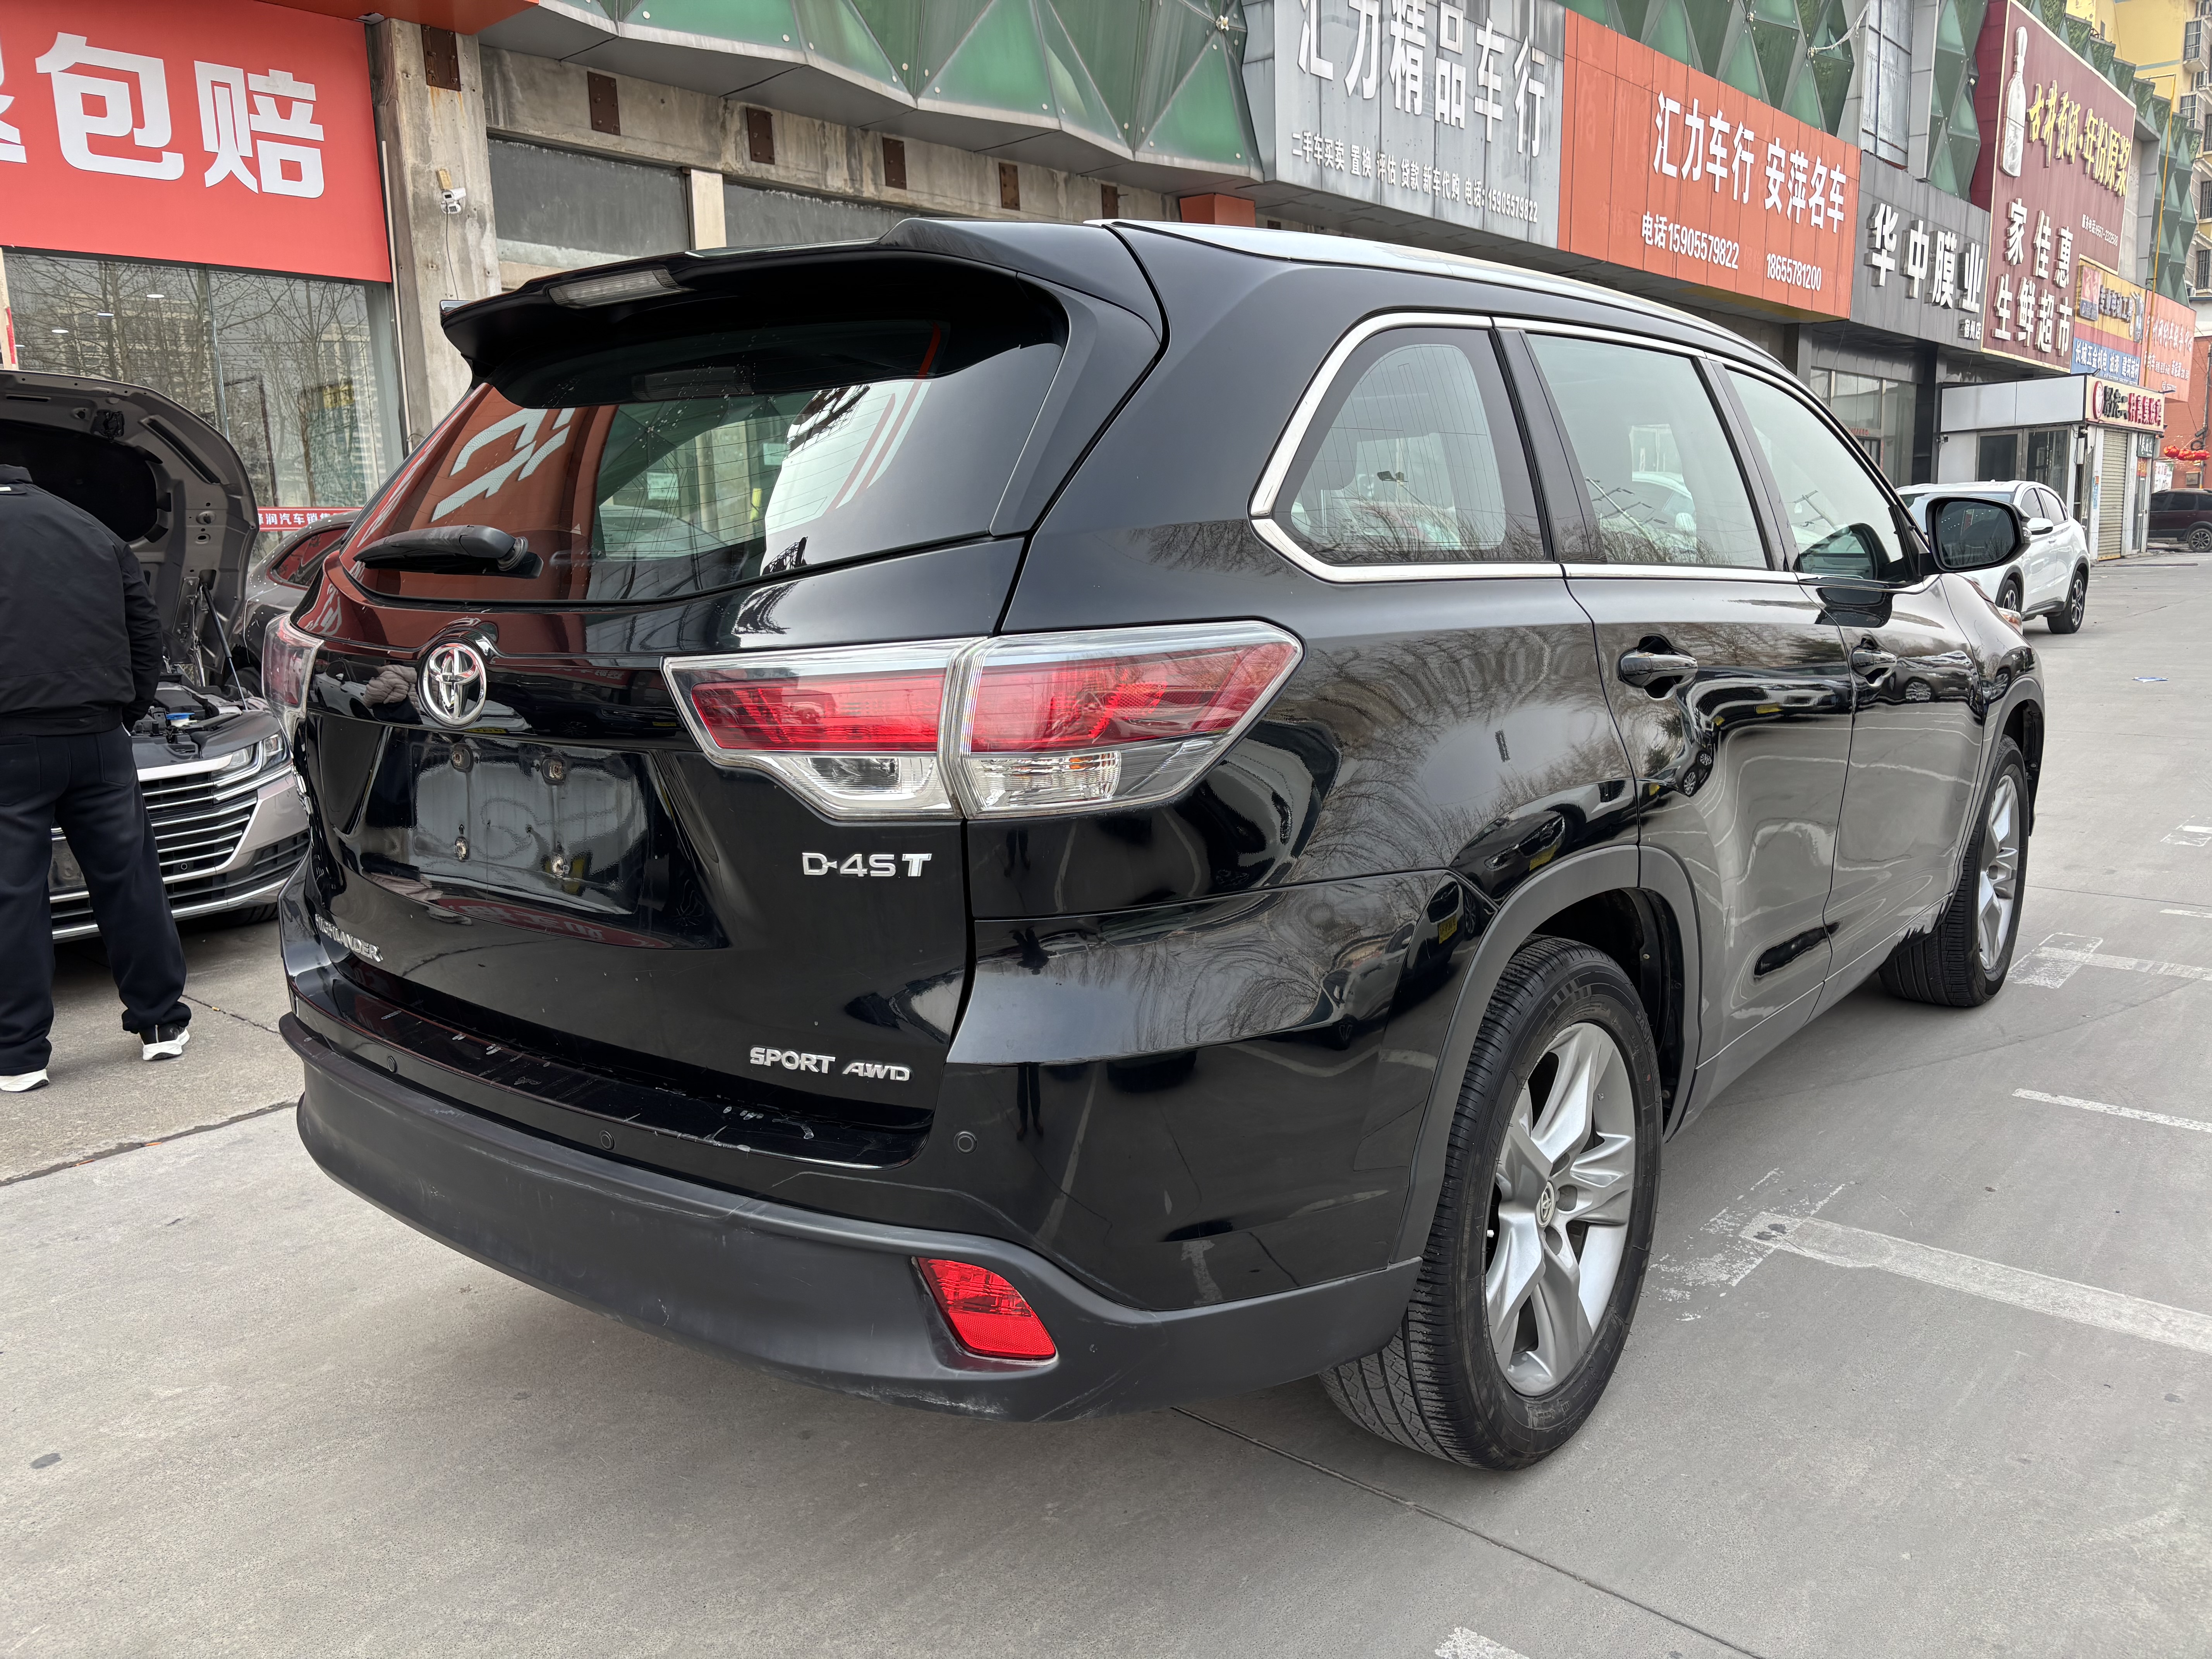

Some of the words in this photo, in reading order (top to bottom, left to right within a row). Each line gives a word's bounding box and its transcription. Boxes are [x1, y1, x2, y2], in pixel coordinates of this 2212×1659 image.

[0, 32, 325, 199] 包赔
[1298, 0, 1546, 158] 汇力精品车行
[1292, 131, 1345, 171] 二手车买卖
[1351, 144, 1371, 178] 置换
[1376, 151, 1396, 185] 评估
[1401, 158, 1419, 191] 贷款
[1422, 164, 1460, 202] 新车代购
[1487, 188, 1538, 223] 15905579822
[1652, 90, 1755, 204] 汇力车行
[1764, 137, 1847, 233] 安萍名车
[1766, 252, 1822, 292] 18655781200
[1869, 203, 1984, 314] 华中膜业
[2005, 198, 2073, 289] 家佳惠
[1963, 319, 1981, 340] 宿州店
[1992, 273, 2074, 356] 生鲜超市
[750, 1046, 836, 1074] SPORT
[842, 1061, 912, 1081] AWD
